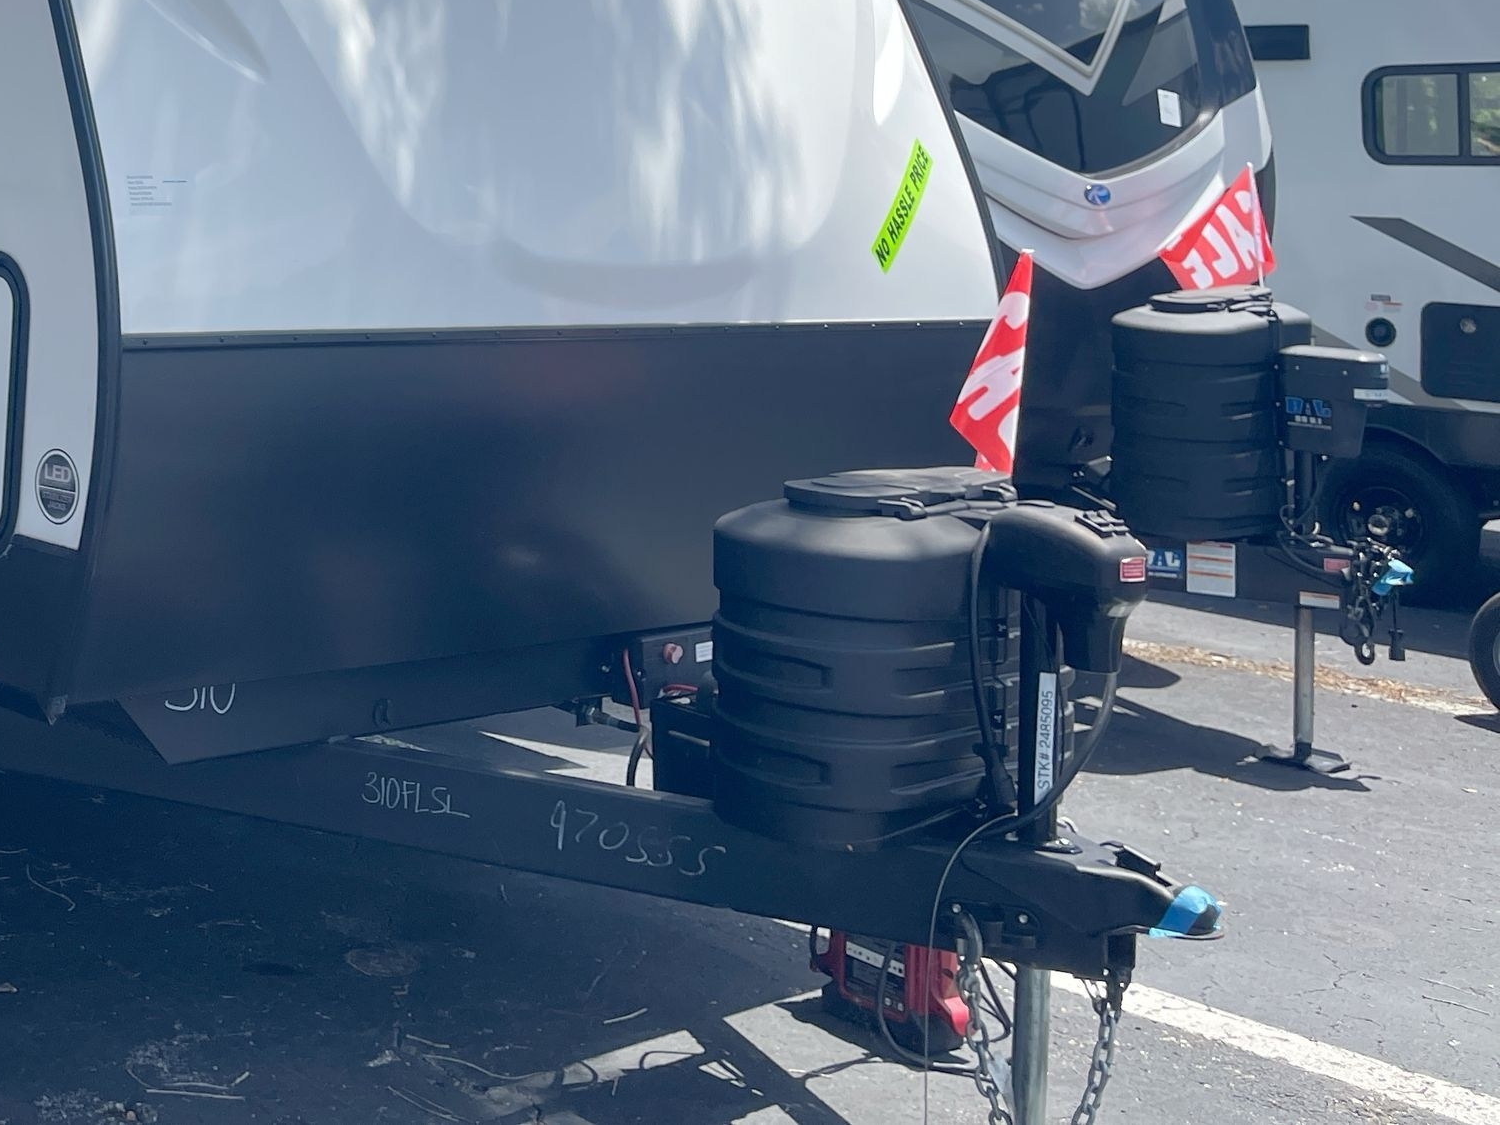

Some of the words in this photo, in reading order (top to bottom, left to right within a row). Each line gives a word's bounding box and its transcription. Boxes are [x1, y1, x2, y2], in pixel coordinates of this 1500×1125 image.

[875, 237, 890, 268] NO
[887, 184, 915, 244] HASSLE
[909, 144, 929, 192] PRICE
[44, 463, 72, 483] LED
[1040, 690, 1053, 748] 2485095
[1037, 753, 1051, 790] STK#
